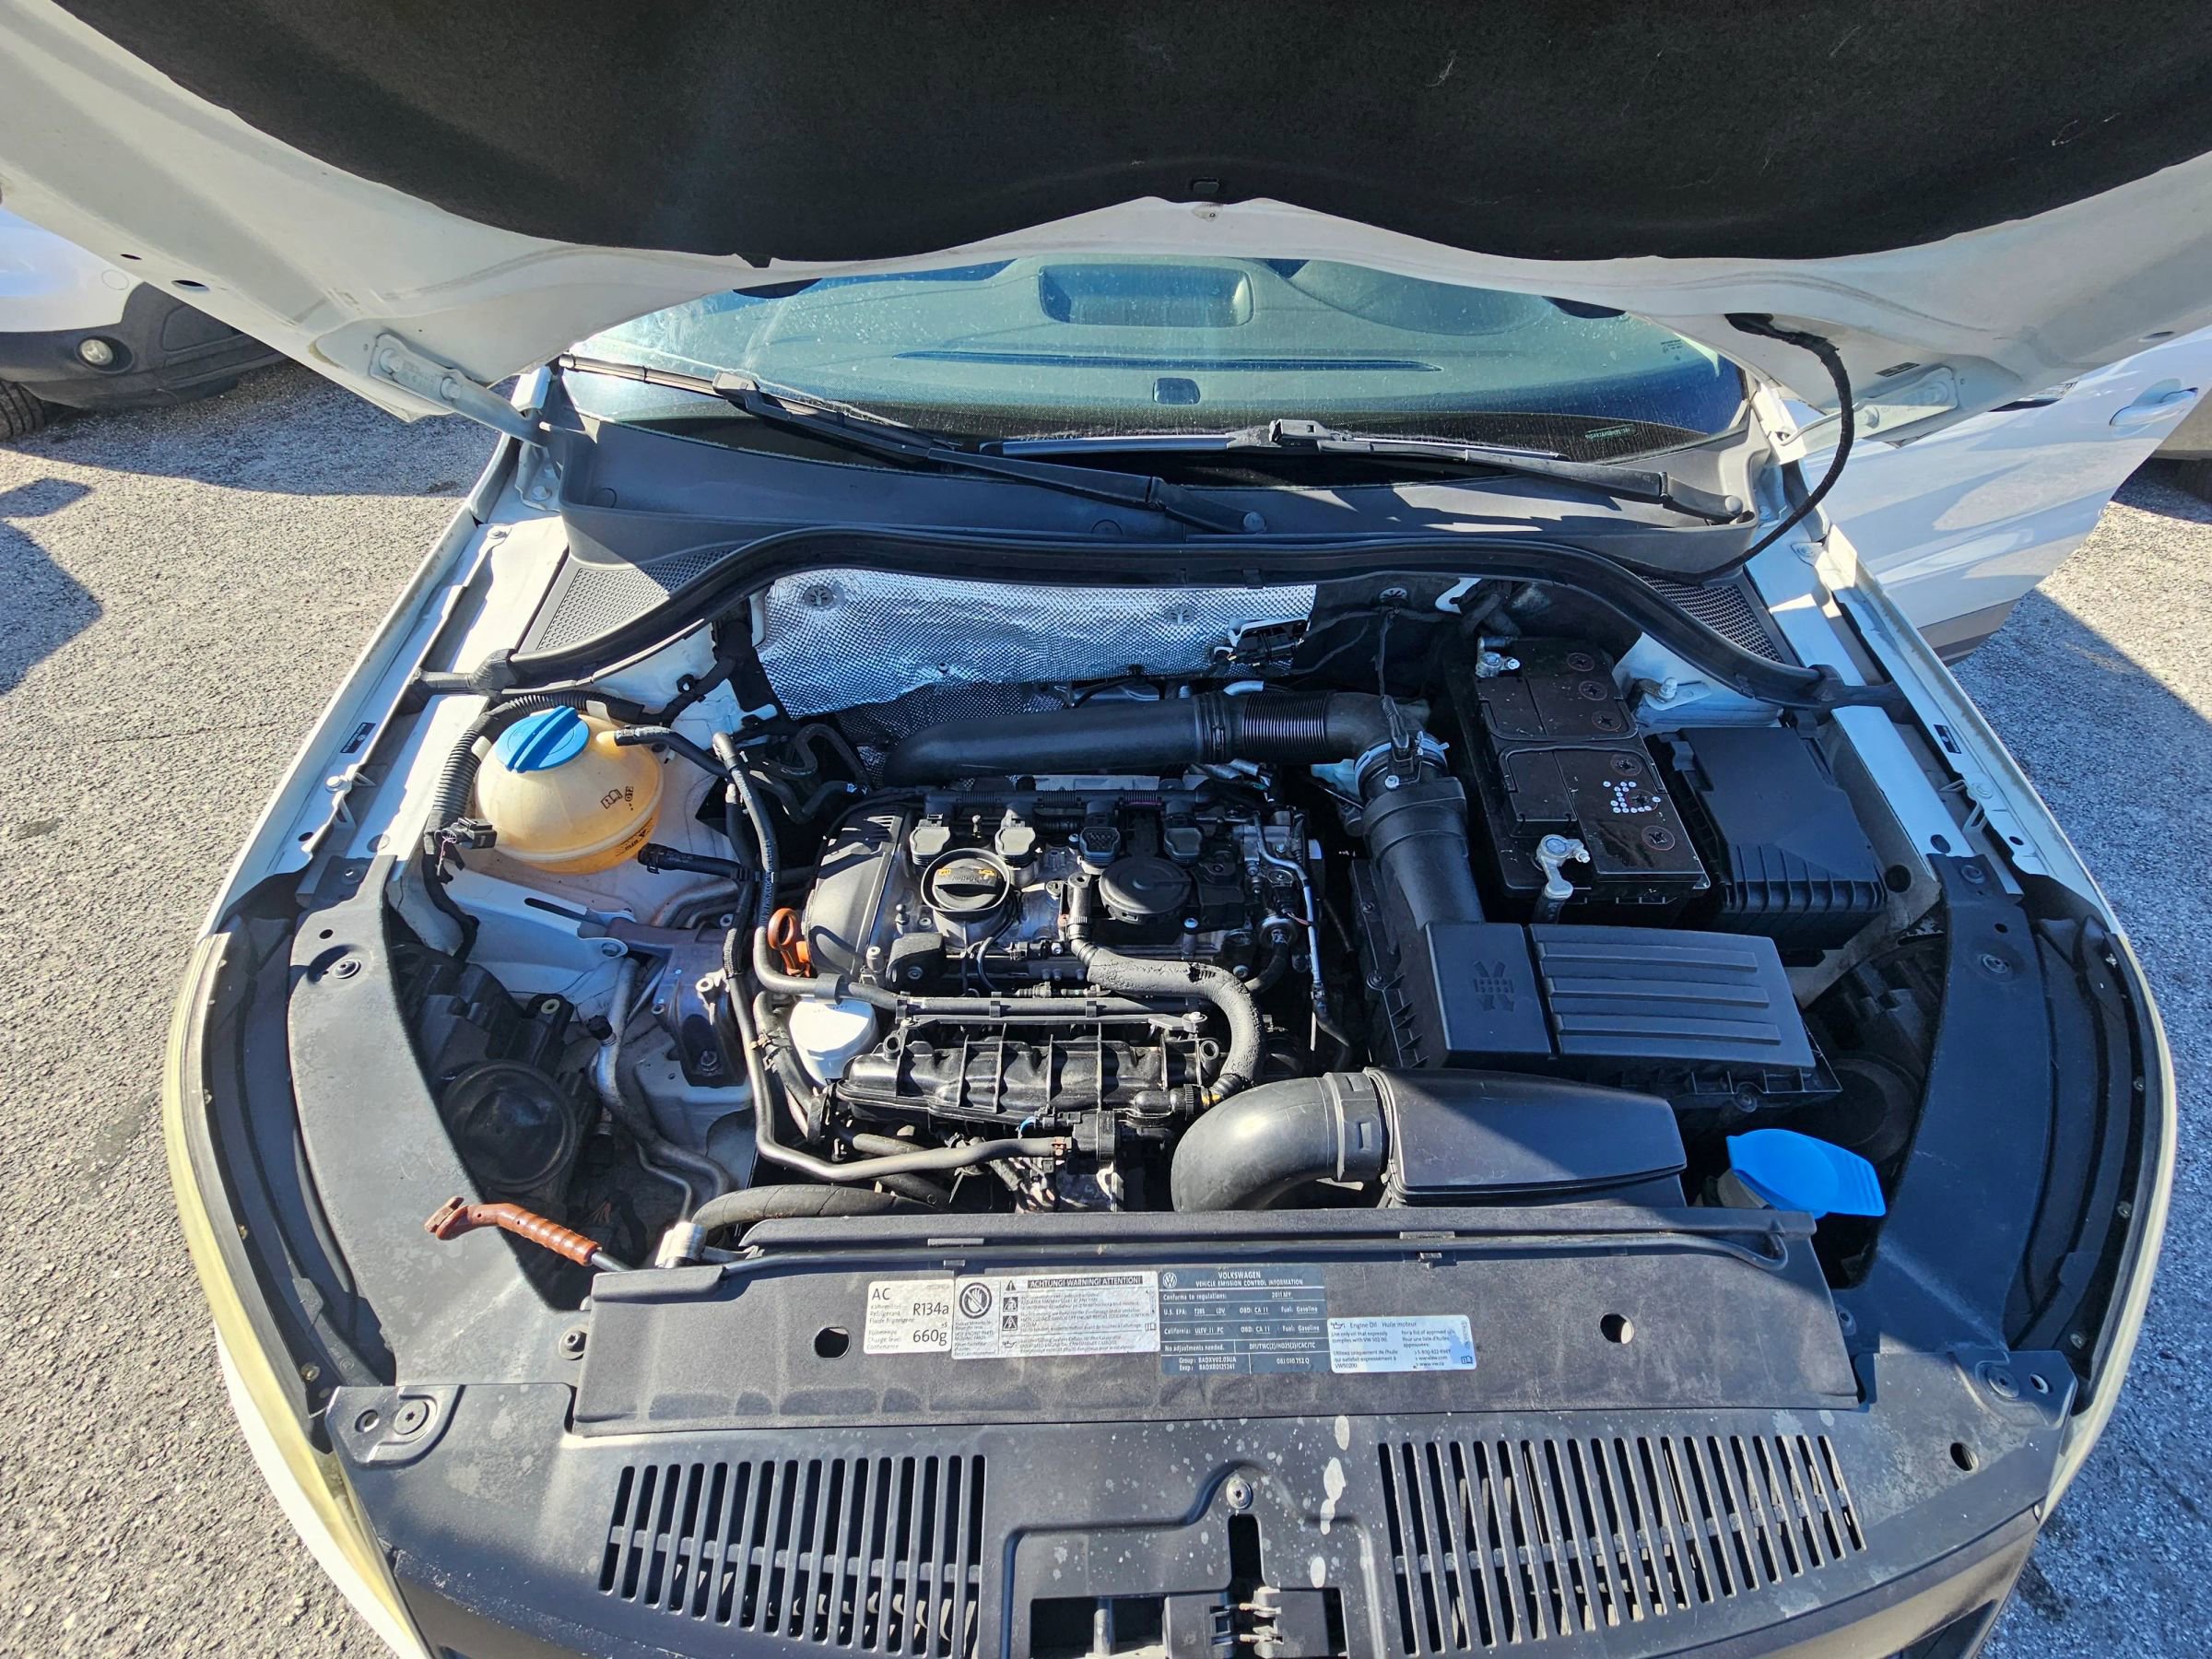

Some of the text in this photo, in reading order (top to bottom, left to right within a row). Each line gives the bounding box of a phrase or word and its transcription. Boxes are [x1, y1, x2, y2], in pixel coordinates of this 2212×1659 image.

[1218, 1271, 1261, 1279] VOLKSWAGEN
[1030, 1279, 1065, 1288] ACHTUNG!
[1067, 1277, 1101, 1287] WARNING!
[872, 1288, 891, 1300] AC
[913, 1302, 949, 1316] R134a
[913, 1329, 947, 1346] 660g
